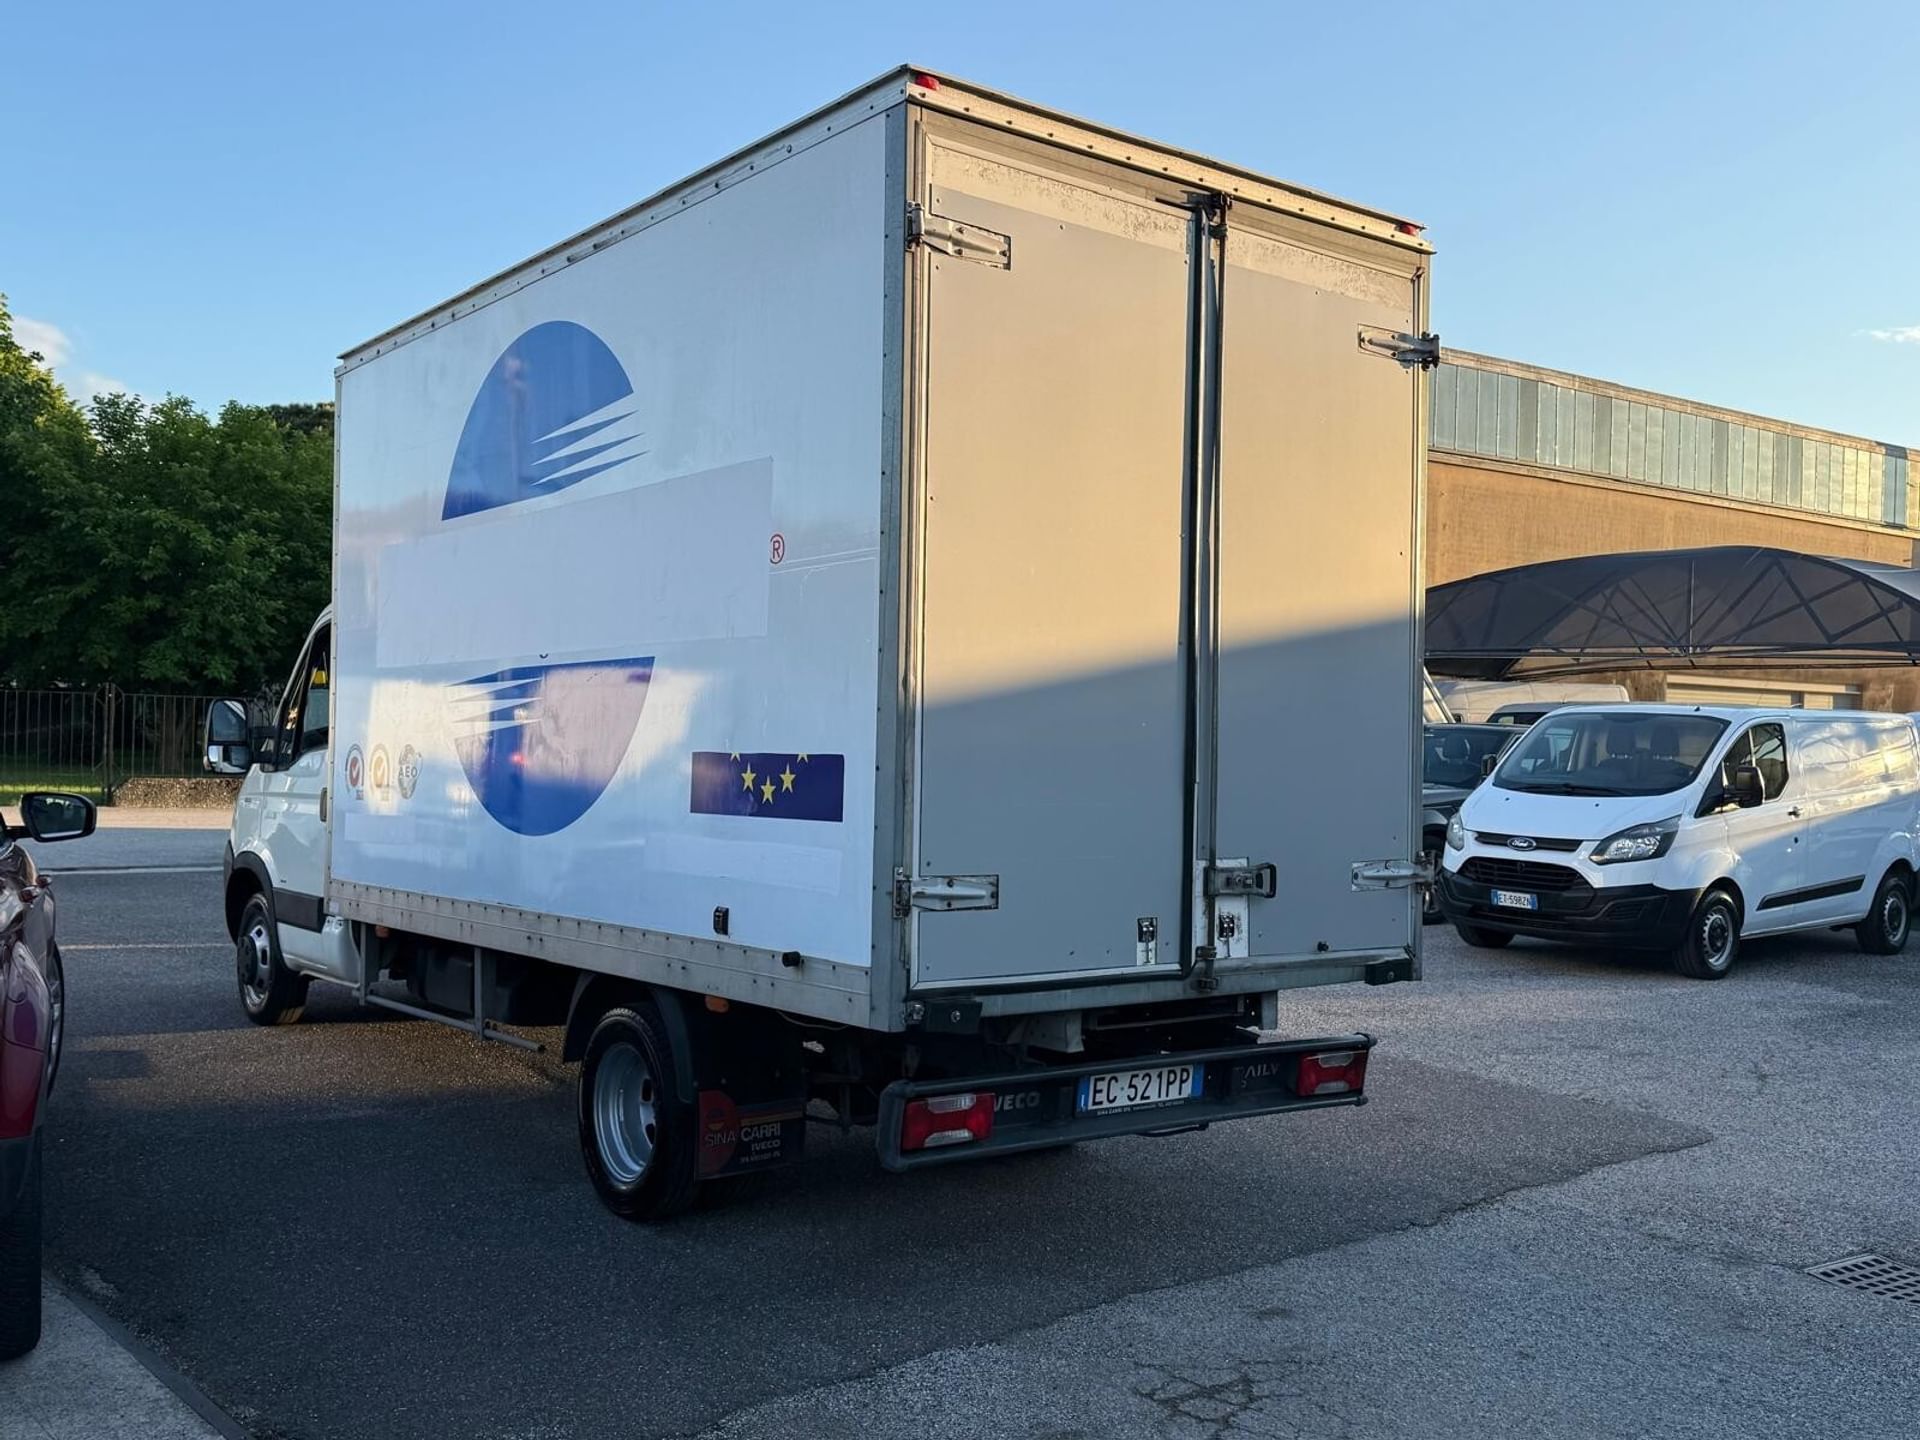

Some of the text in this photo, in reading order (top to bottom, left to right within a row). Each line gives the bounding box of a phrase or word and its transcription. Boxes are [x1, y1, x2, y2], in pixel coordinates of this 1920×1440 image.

[398, 765, 418, 778] AEO
[1092, 1075, 1119, 1106] EC
[1127, 1067, 1191, 1102] 521PP
[992, 1090, 1041, 1113] VECO
[703, 1122, 782, 1148] SINA CARRI
[751, 1138, 782, 1151] IVECO
